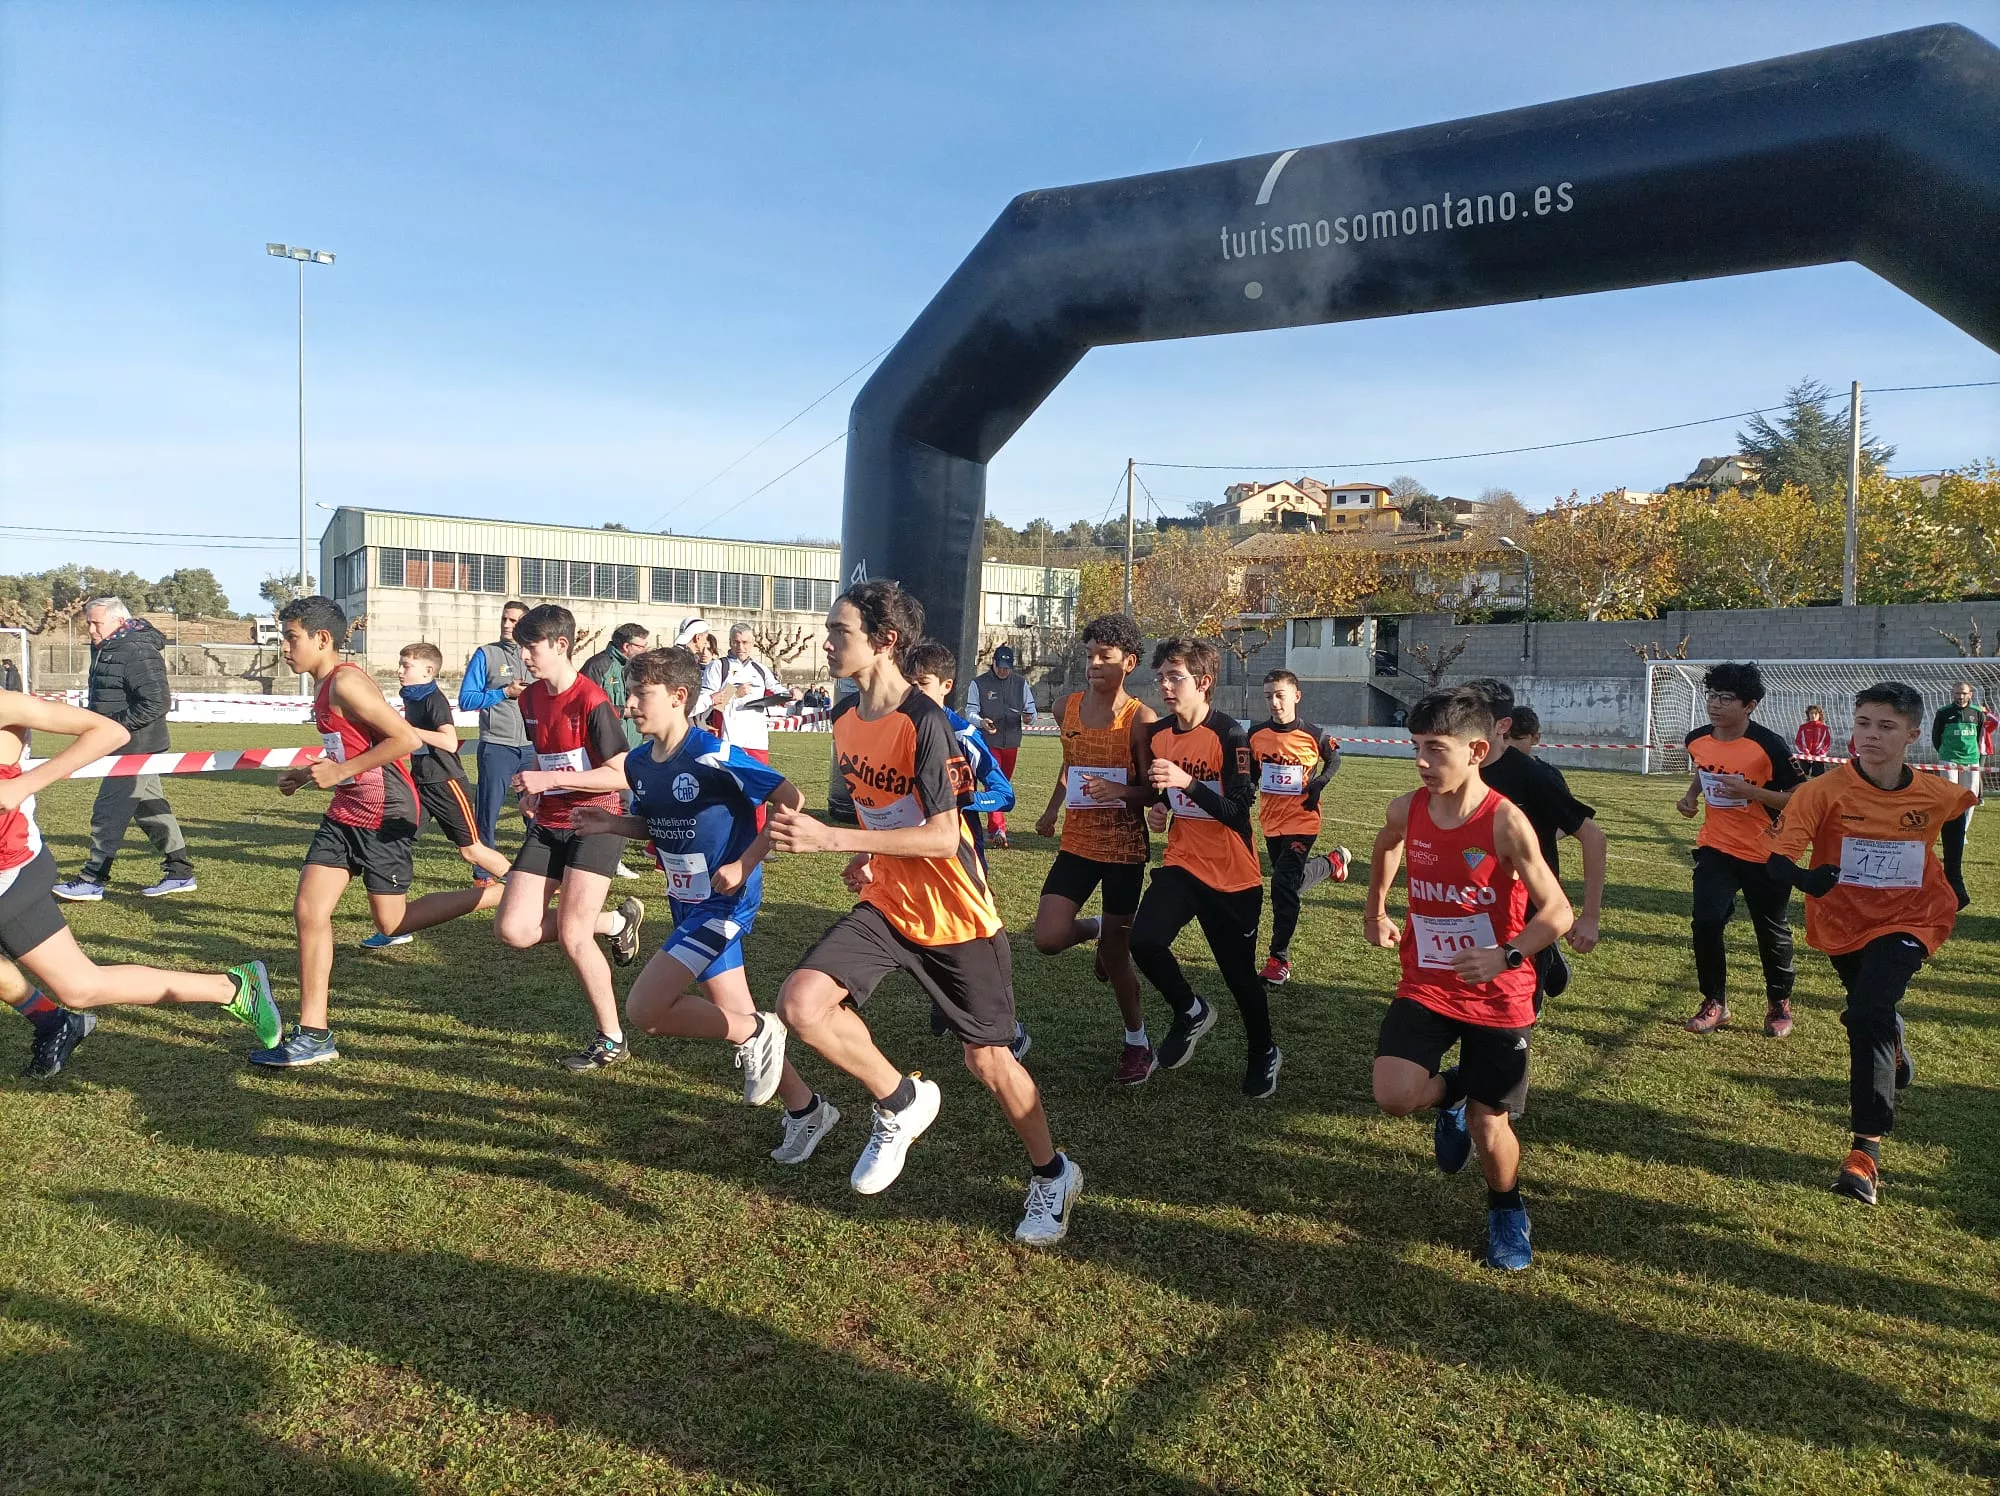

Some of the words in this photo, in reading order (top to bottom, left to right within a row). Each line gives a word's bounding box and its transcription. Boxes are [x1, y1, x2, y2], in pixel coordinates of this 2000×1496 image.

[1220, 181, 1575, 261] turismosomontano.es
[1270, 774, 1292, 785] 132
[678, 786, 694, 800] CAB
[1856, 854, 1900, 876] 174
[672, 873, 692, 889] 67
[1432, 934, 1475, 952] 110
